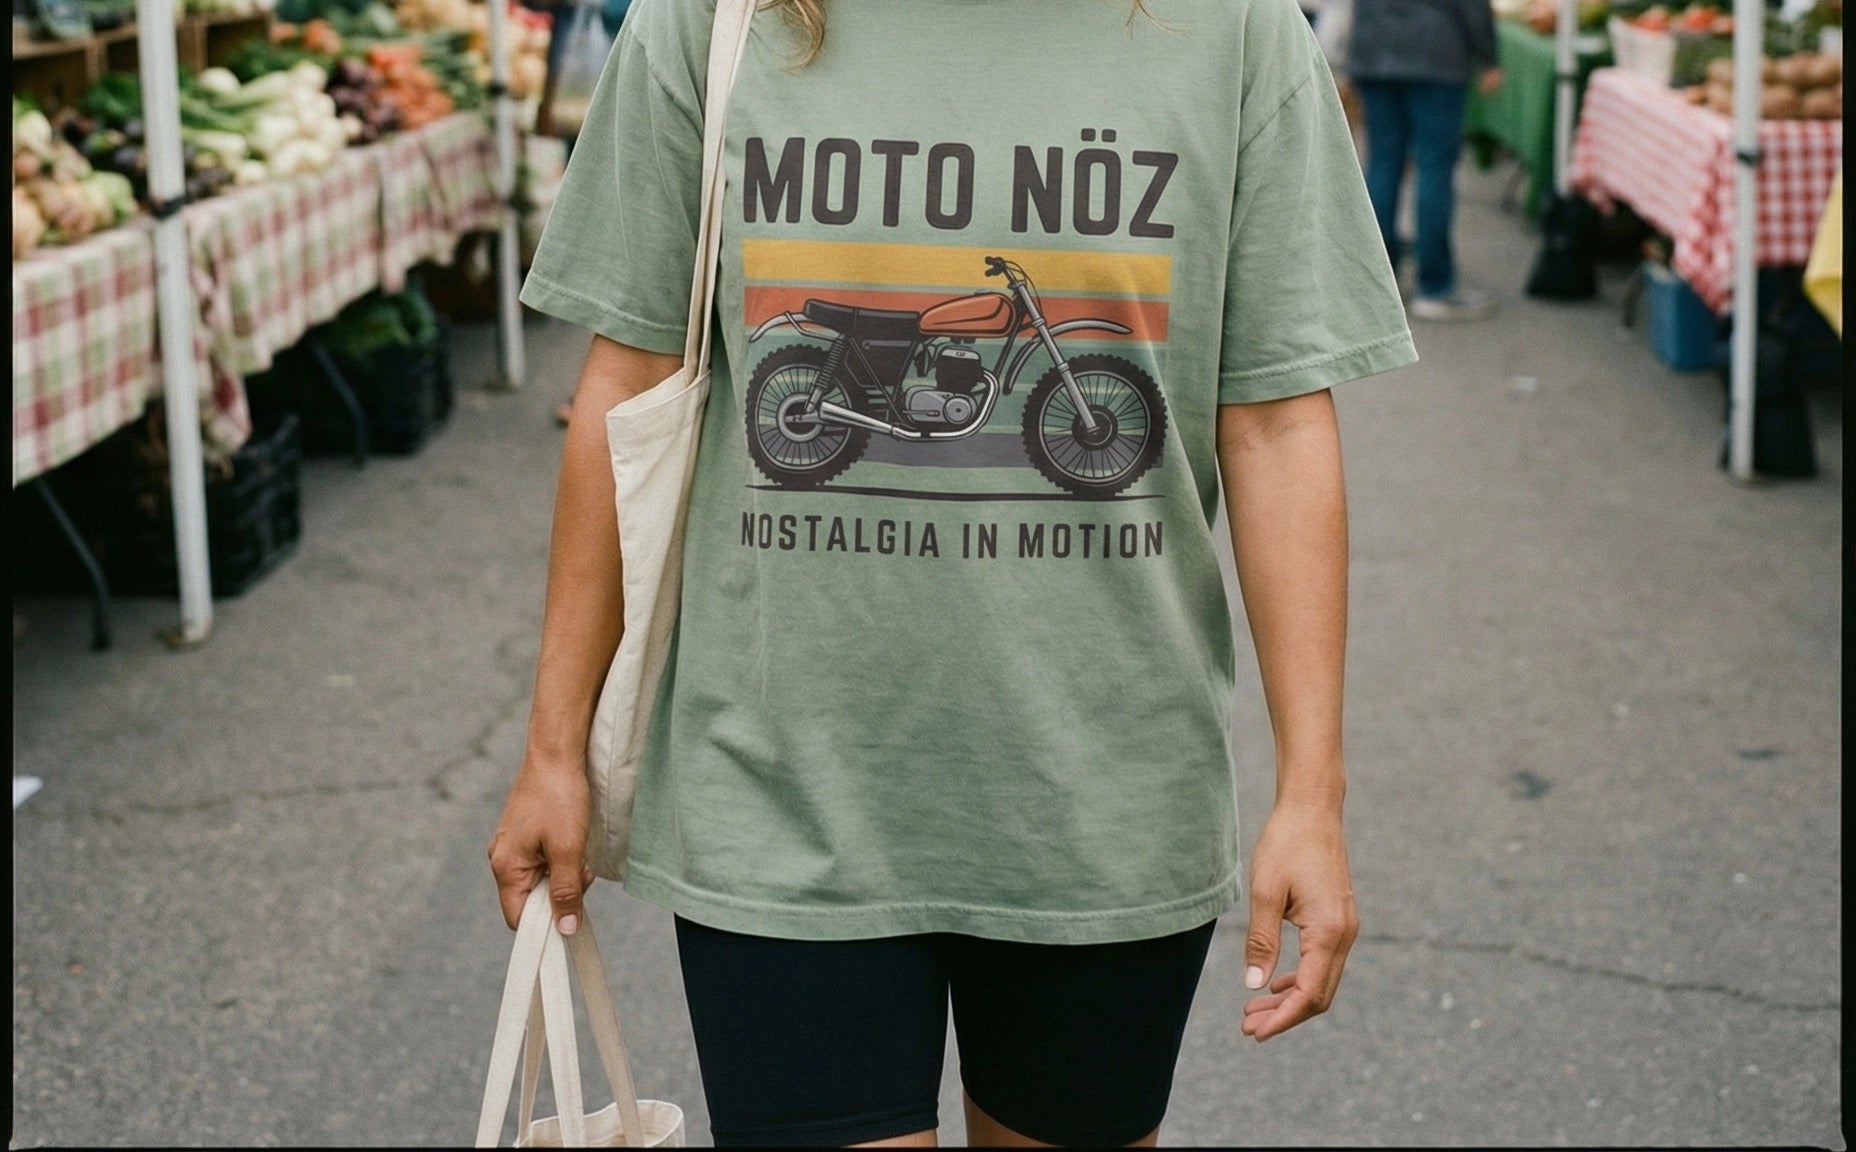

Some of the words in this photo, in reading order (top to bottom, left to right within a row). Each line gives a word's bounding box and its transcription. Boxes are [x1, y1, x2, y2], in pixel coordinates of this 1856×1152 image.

[743, 136, 975, 230] MOTO
[1011, 128, 1179, 238] NÖZ
[741, 512, 939, 558] NOSTALGIA
[962, 523, 998, 559] IN
[1018, 521, 1163, 559] MOTION
